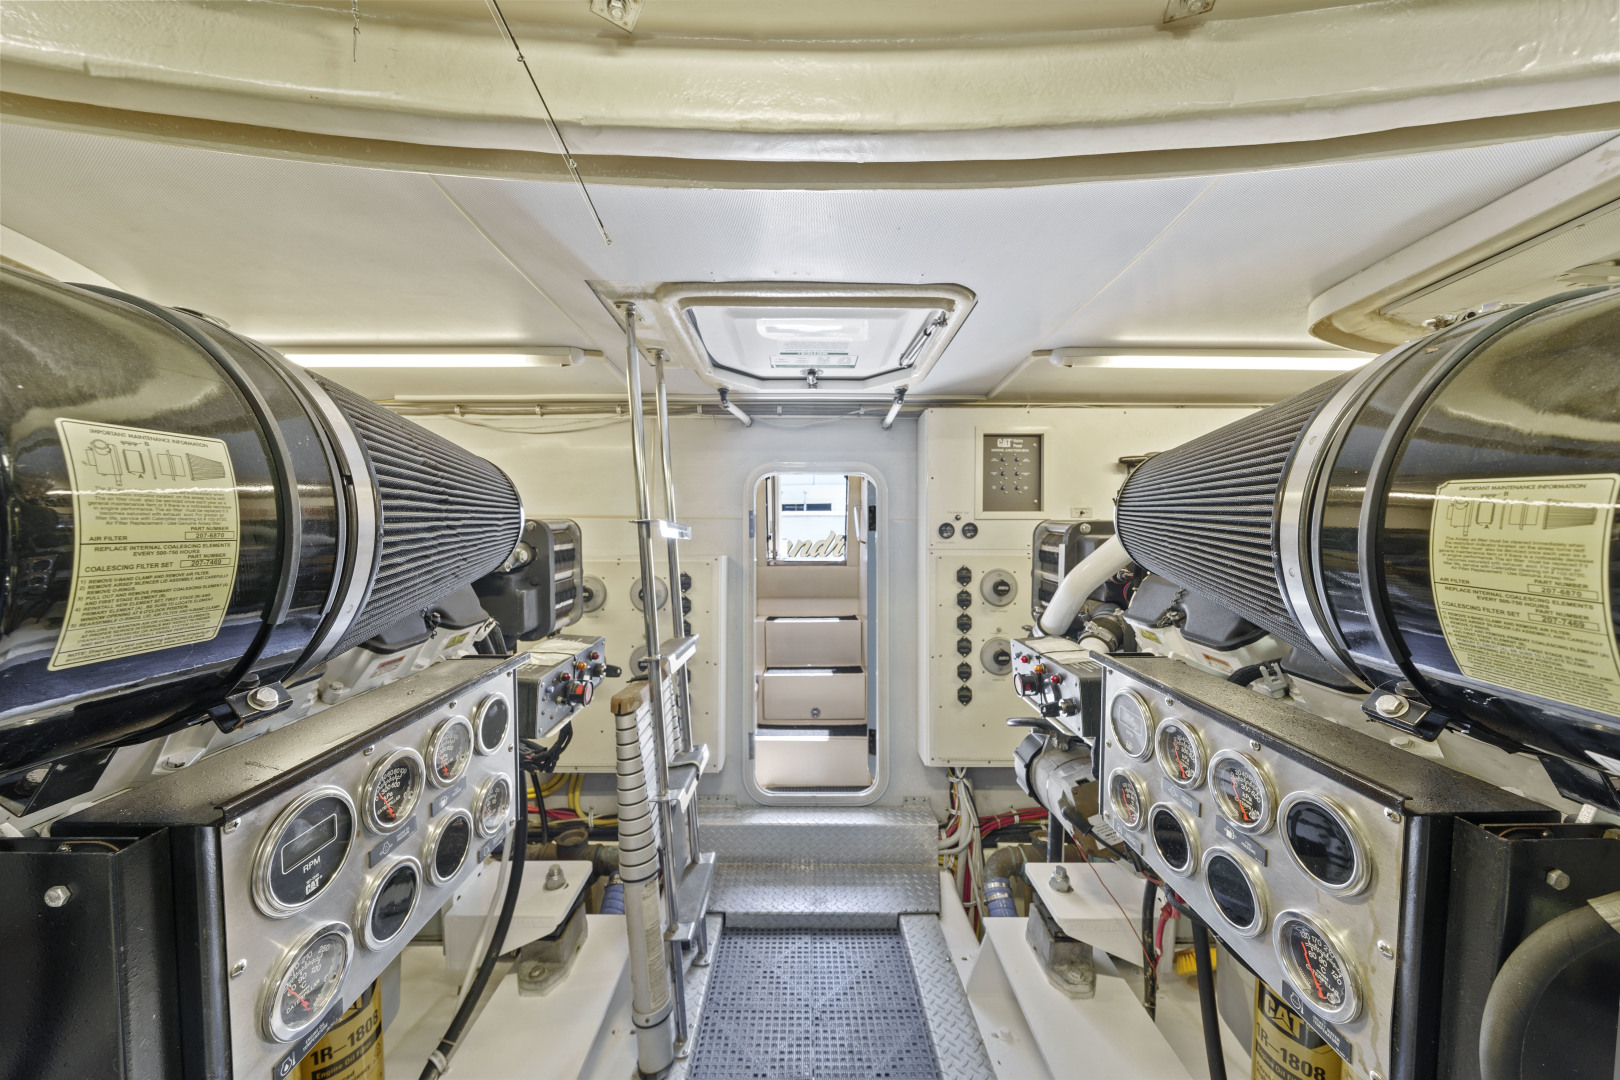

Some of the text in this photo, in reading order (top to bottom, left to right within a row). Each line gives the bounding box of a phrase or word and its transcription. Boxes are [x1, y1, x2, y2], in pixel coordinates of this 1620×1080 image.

[90, 429, 209, 448] IMPORTANT MAINTENANCE INFORMATION
[85, 564, 134, 573] COALESCING
[1445, 586, 1594, 610] REPLACE INTERNAL COALESCING ELEMENTS
[1542, 587, 1582, 597] 207-6870
[1442, 600, 1481, 611] COALESCING
[1482, 607, 1505, 615] FILTER
[1507, 610, 1520, 618] SET
[1556, 612, 1589, 620] NUMBER
[303, 856, 321, 873] RPM
[305, 878, 320, 895] CAT
[1264, 994, 1305, 1039] CAT
[317, 1063, 343, 1079] Engine
[344, 1055, 356, 1066] Oil
